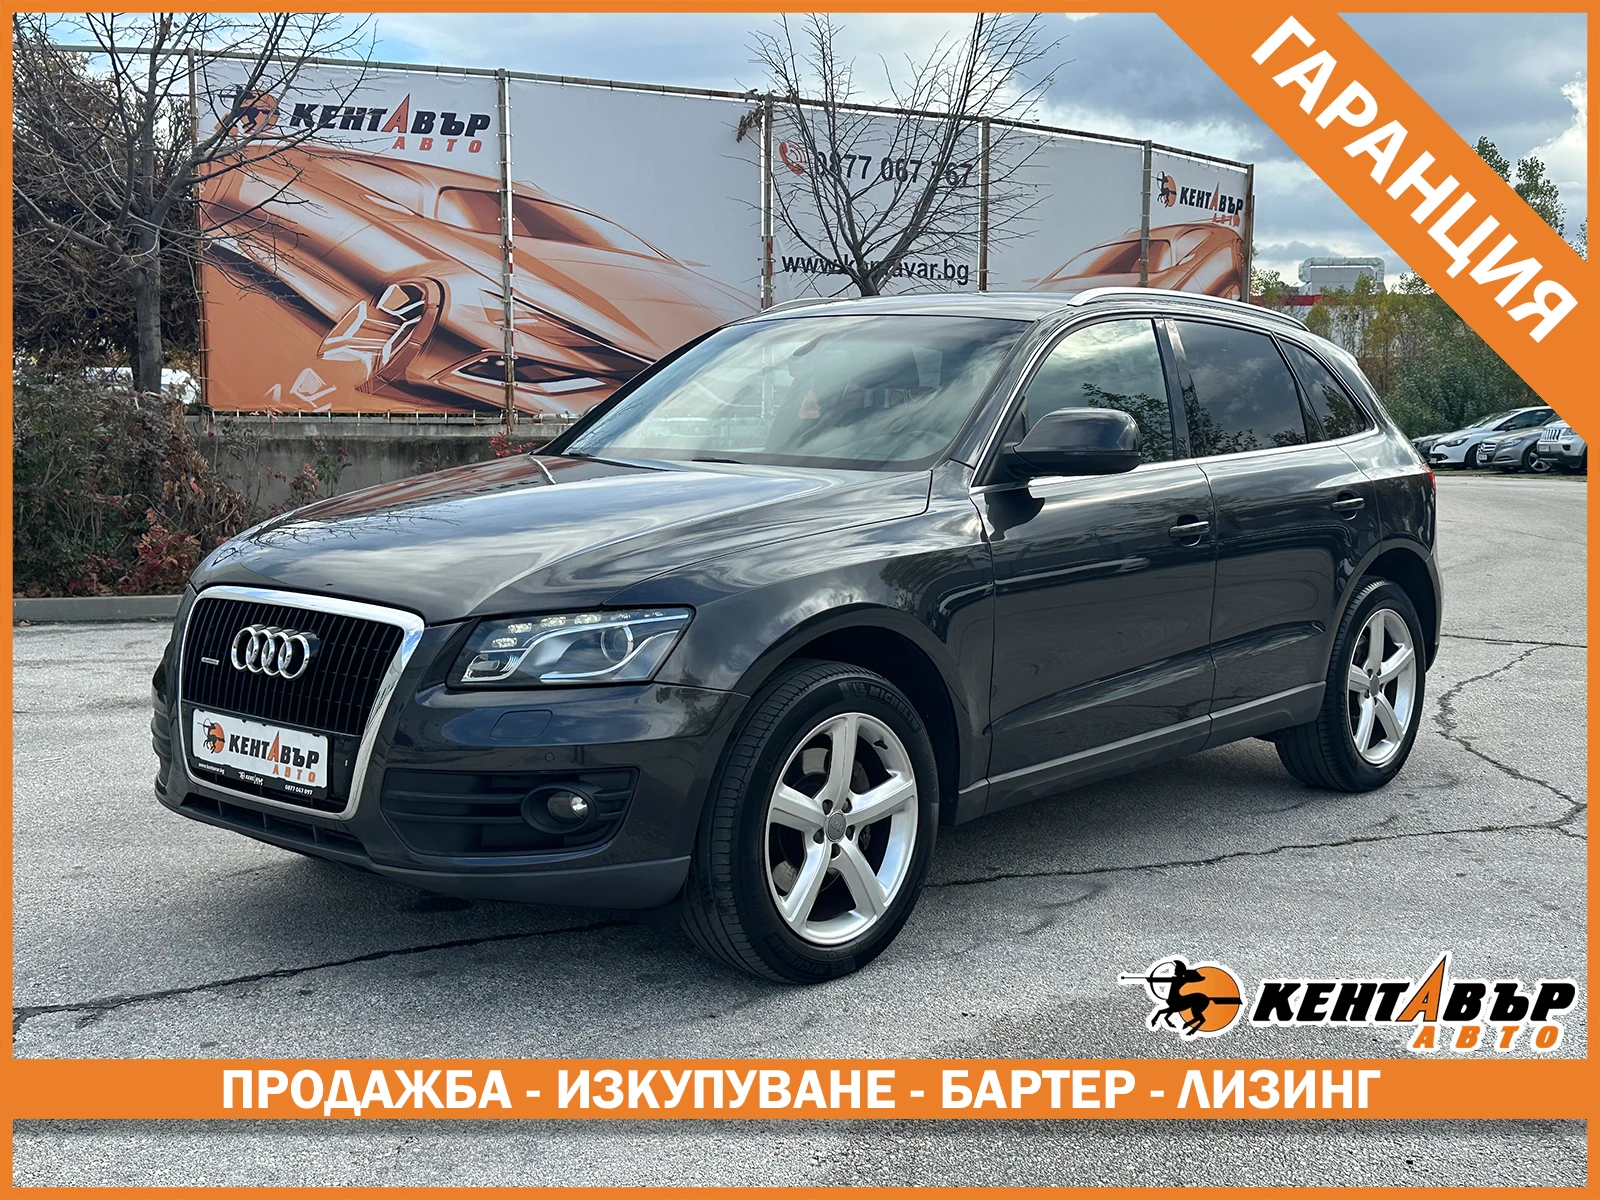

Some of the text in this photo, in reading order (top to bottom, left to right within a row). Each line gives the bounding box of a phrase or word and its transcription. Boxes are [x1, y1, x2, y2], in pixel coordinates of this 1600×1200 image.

[290, 93, 491, 137] КЕНТАВЪР
[392, 136, 482, 153] АВТО
[881, 157, 923, 183] 067
[1179, 182, 1244, 215] КЕНТАВЪР
[782, 254, 969, 285] wwwkavar.bg
[868, 685, 920, 732] MICHELIN
[228, 730, 320, 769] КЕНТАВЪР
[272, 764, 316, 783] АВТО
